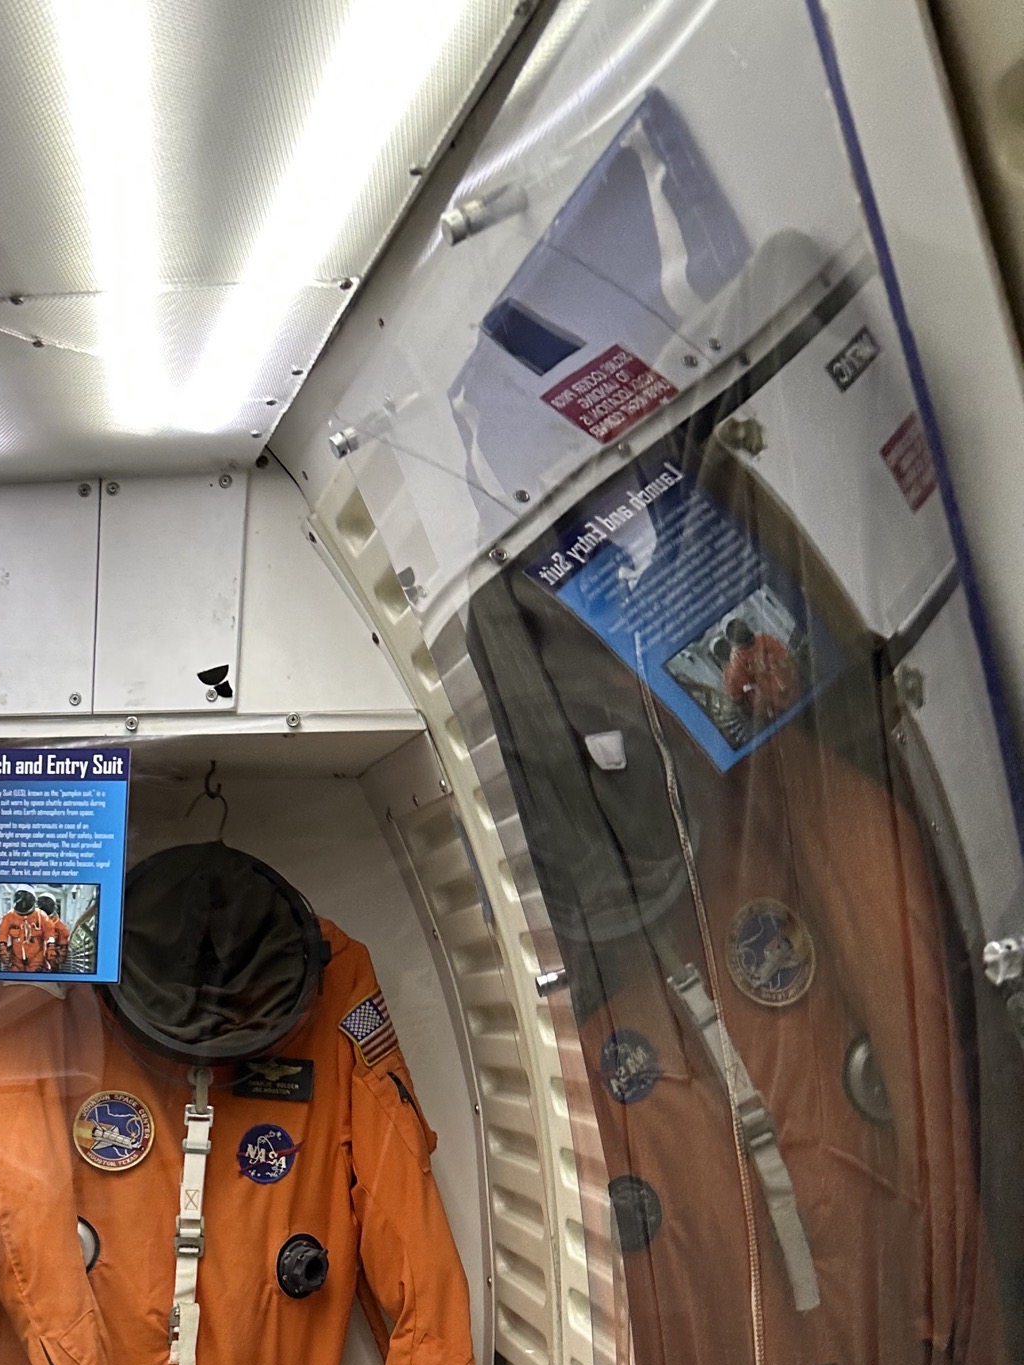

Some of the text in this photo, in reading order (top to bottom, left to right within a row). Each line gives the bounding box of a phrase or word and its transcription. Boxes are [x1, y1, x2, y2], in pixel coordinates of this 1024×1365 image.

[15, 754, 43, 775] and
[47, 754, 89, 779] Entry
[92, 754, 124, 775] Suit
[245, 1143, 287, 1169] NASA
